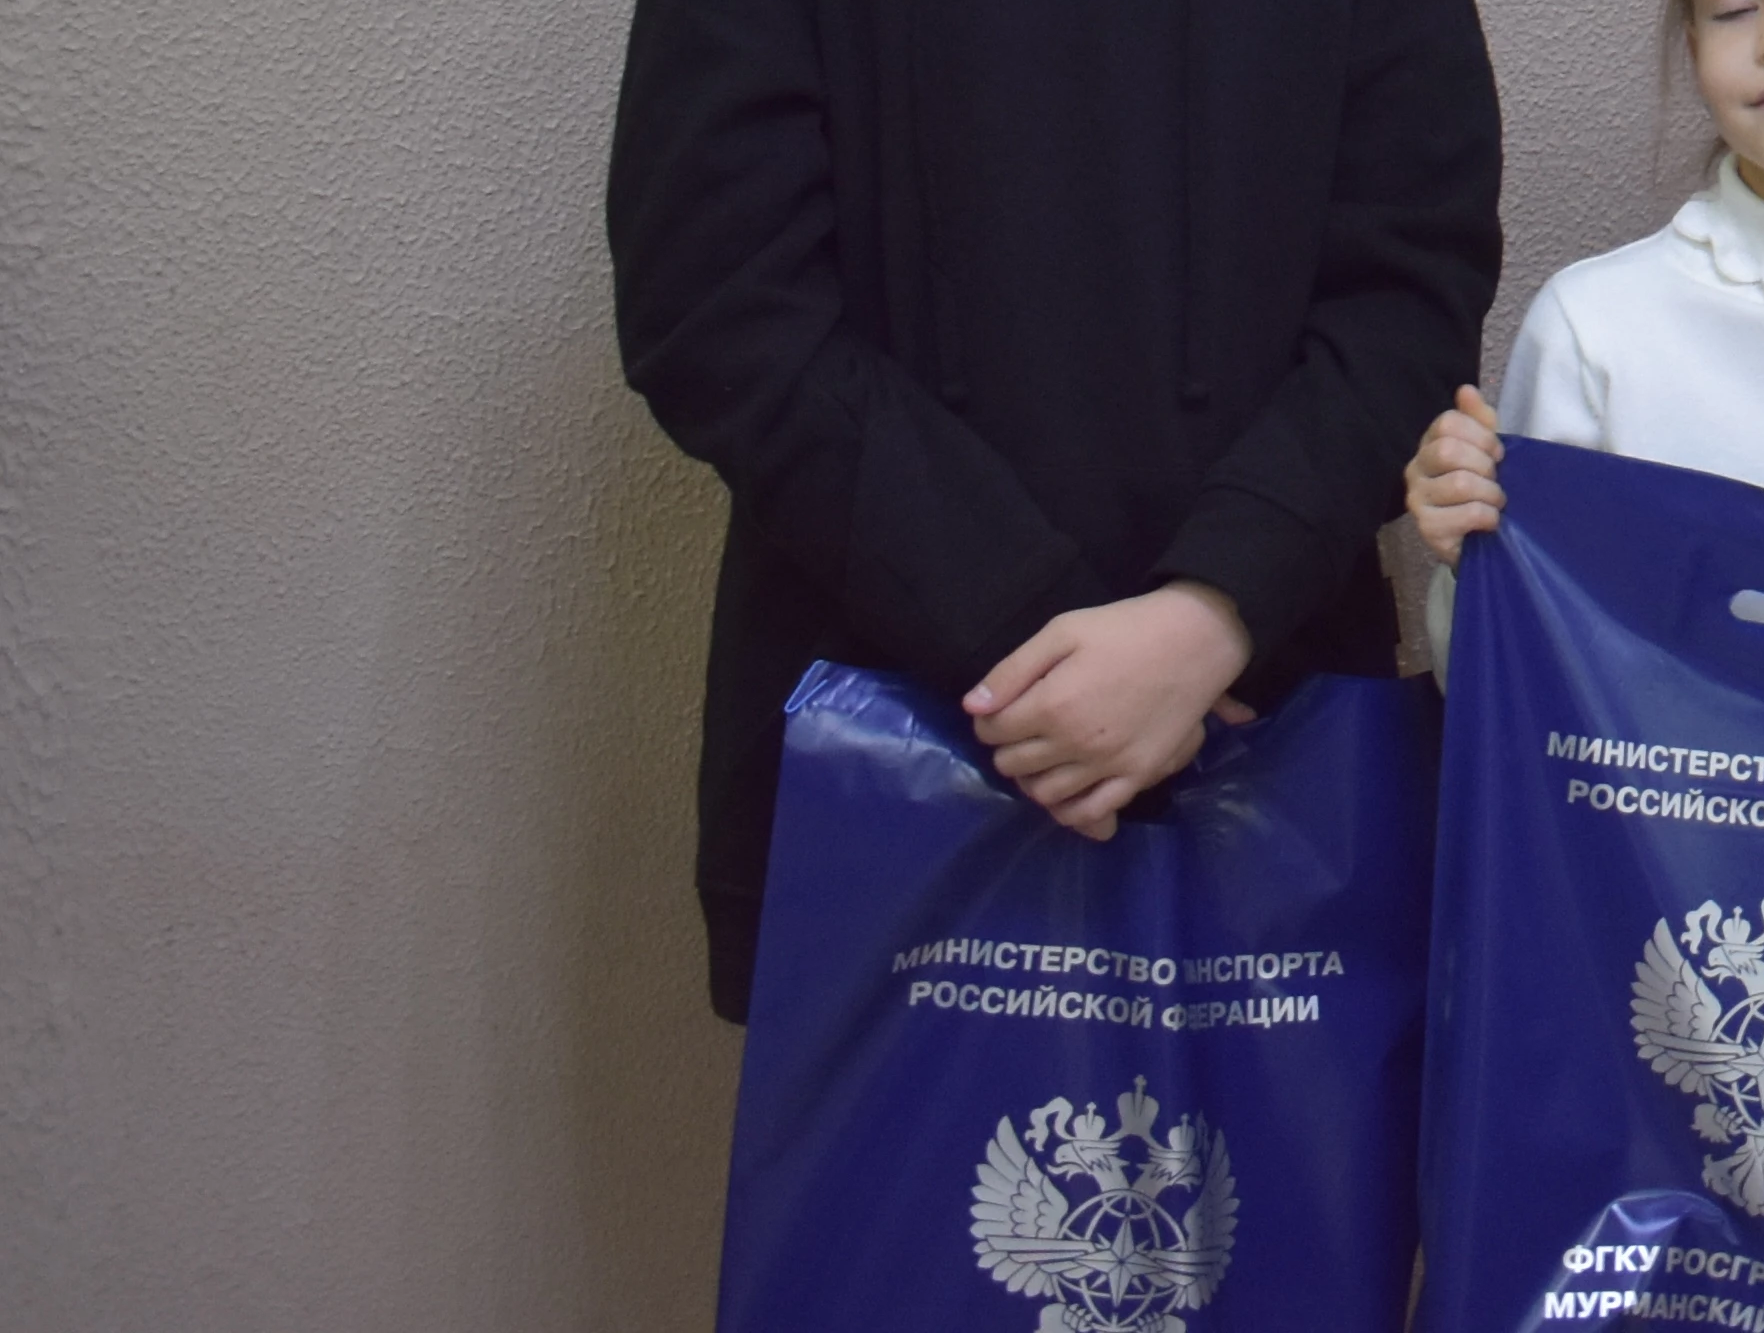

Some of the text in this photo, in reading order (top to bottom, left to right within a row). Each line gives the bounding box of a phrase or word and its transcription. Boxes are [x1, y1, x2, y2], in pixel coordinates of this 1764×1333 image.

[892, 938, 1177, 985] МИНИСТЕРСТВО
[908, 980, 1153, 1029] РОССИЙСКОЙ
[1563, 1244, 1661, 1275] ФГКУ
